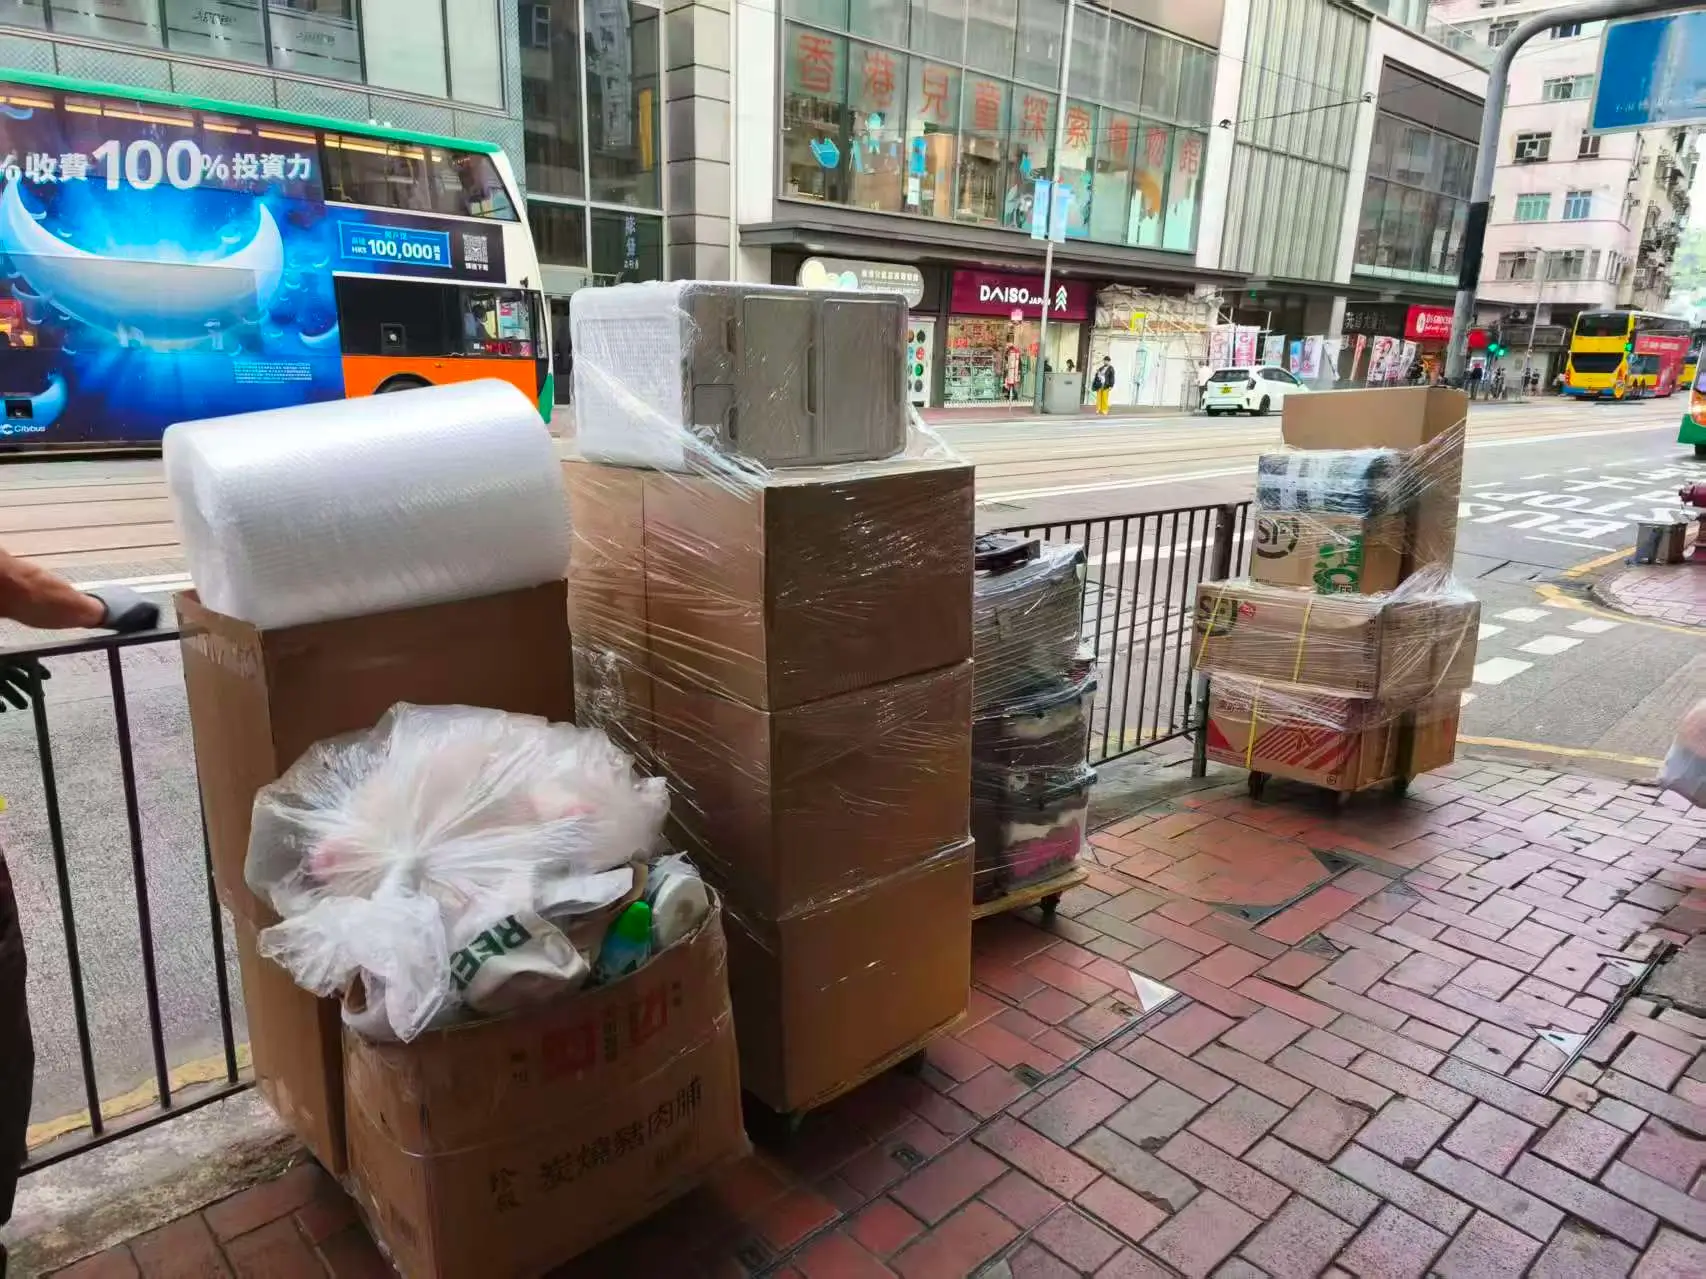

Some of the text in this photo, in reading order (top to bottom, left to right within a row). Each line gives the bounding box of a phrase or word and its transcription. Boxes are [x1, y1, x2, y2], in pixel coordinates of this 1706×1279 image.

[25, 151, 90, 183] 收費
[92, 138, 229, 191] 100%
[232, 150, 312, 182] 投資力
[368, 239, 432, 260] 100,000
[980, 284, 1029, 304] DAISO
[14, 424, 46, 433] Citybus
